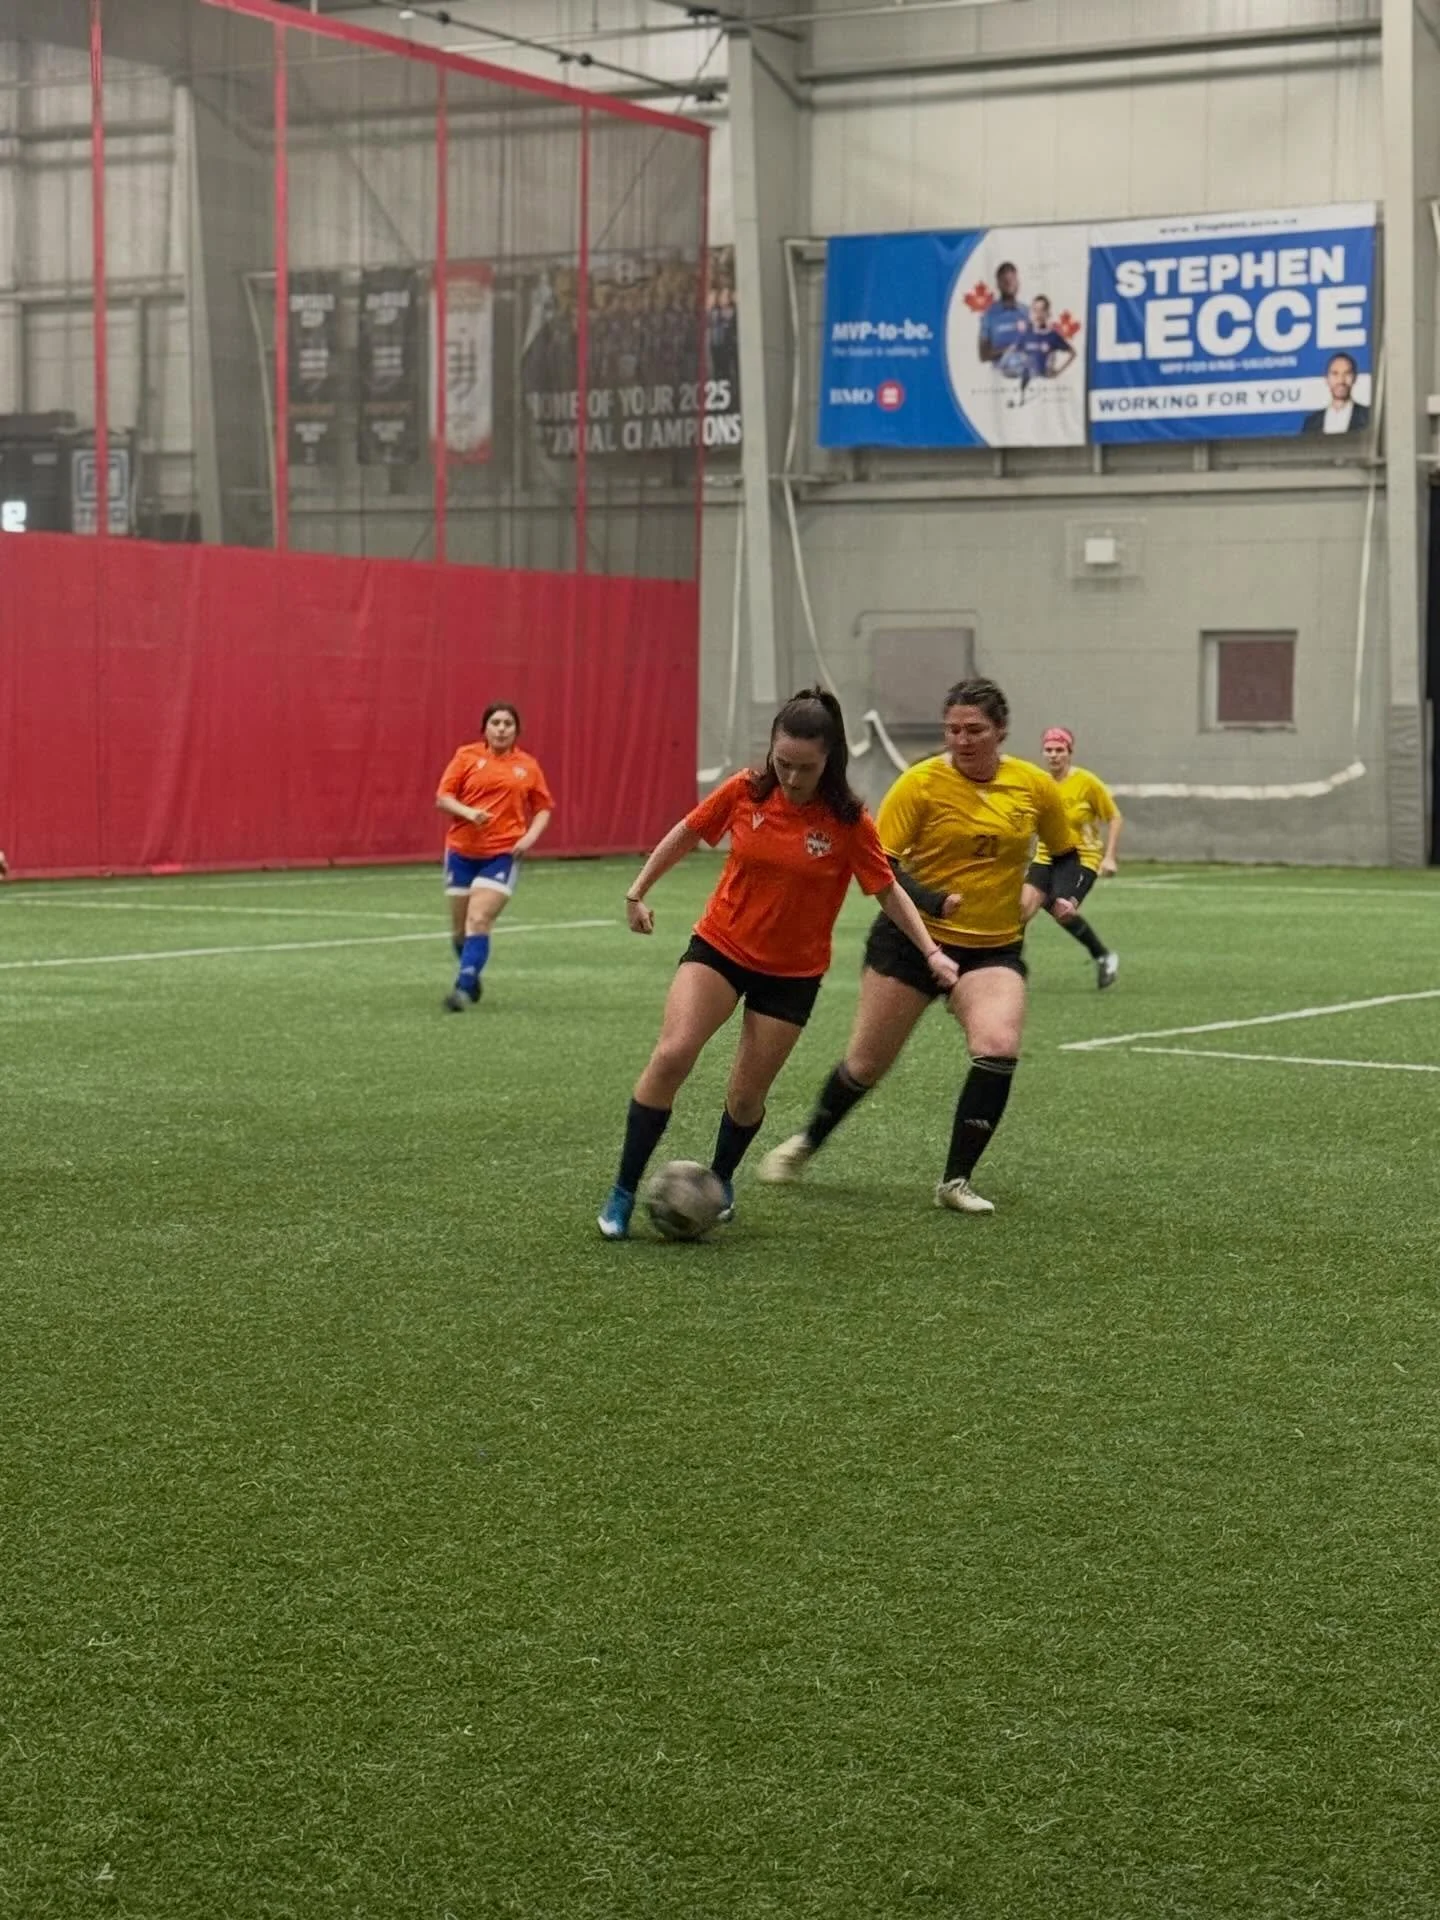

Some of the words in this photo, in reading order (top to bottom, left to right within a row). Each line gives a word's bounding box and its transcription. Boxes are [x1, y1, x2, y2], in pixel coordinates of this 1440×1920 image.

[1115, 245, 1345, 297] STEPHEN
[831, 318, 934, 341] MVP-to-be.
[1096, 285, 1367, 362] LECCE
[588, 388, 614, 417] OF
[619, 385, 674, 416] YOUR
[679, 380, 731, 412] 2025
[829, 387, 874, 404] BMO
[1098, 394, 1199, 413] WORKING
[1207, 390, 1248, 409] FOR
[1256, 387, 1301, 405] YOU
[623, 414, 742, 448] CHAMPONS
